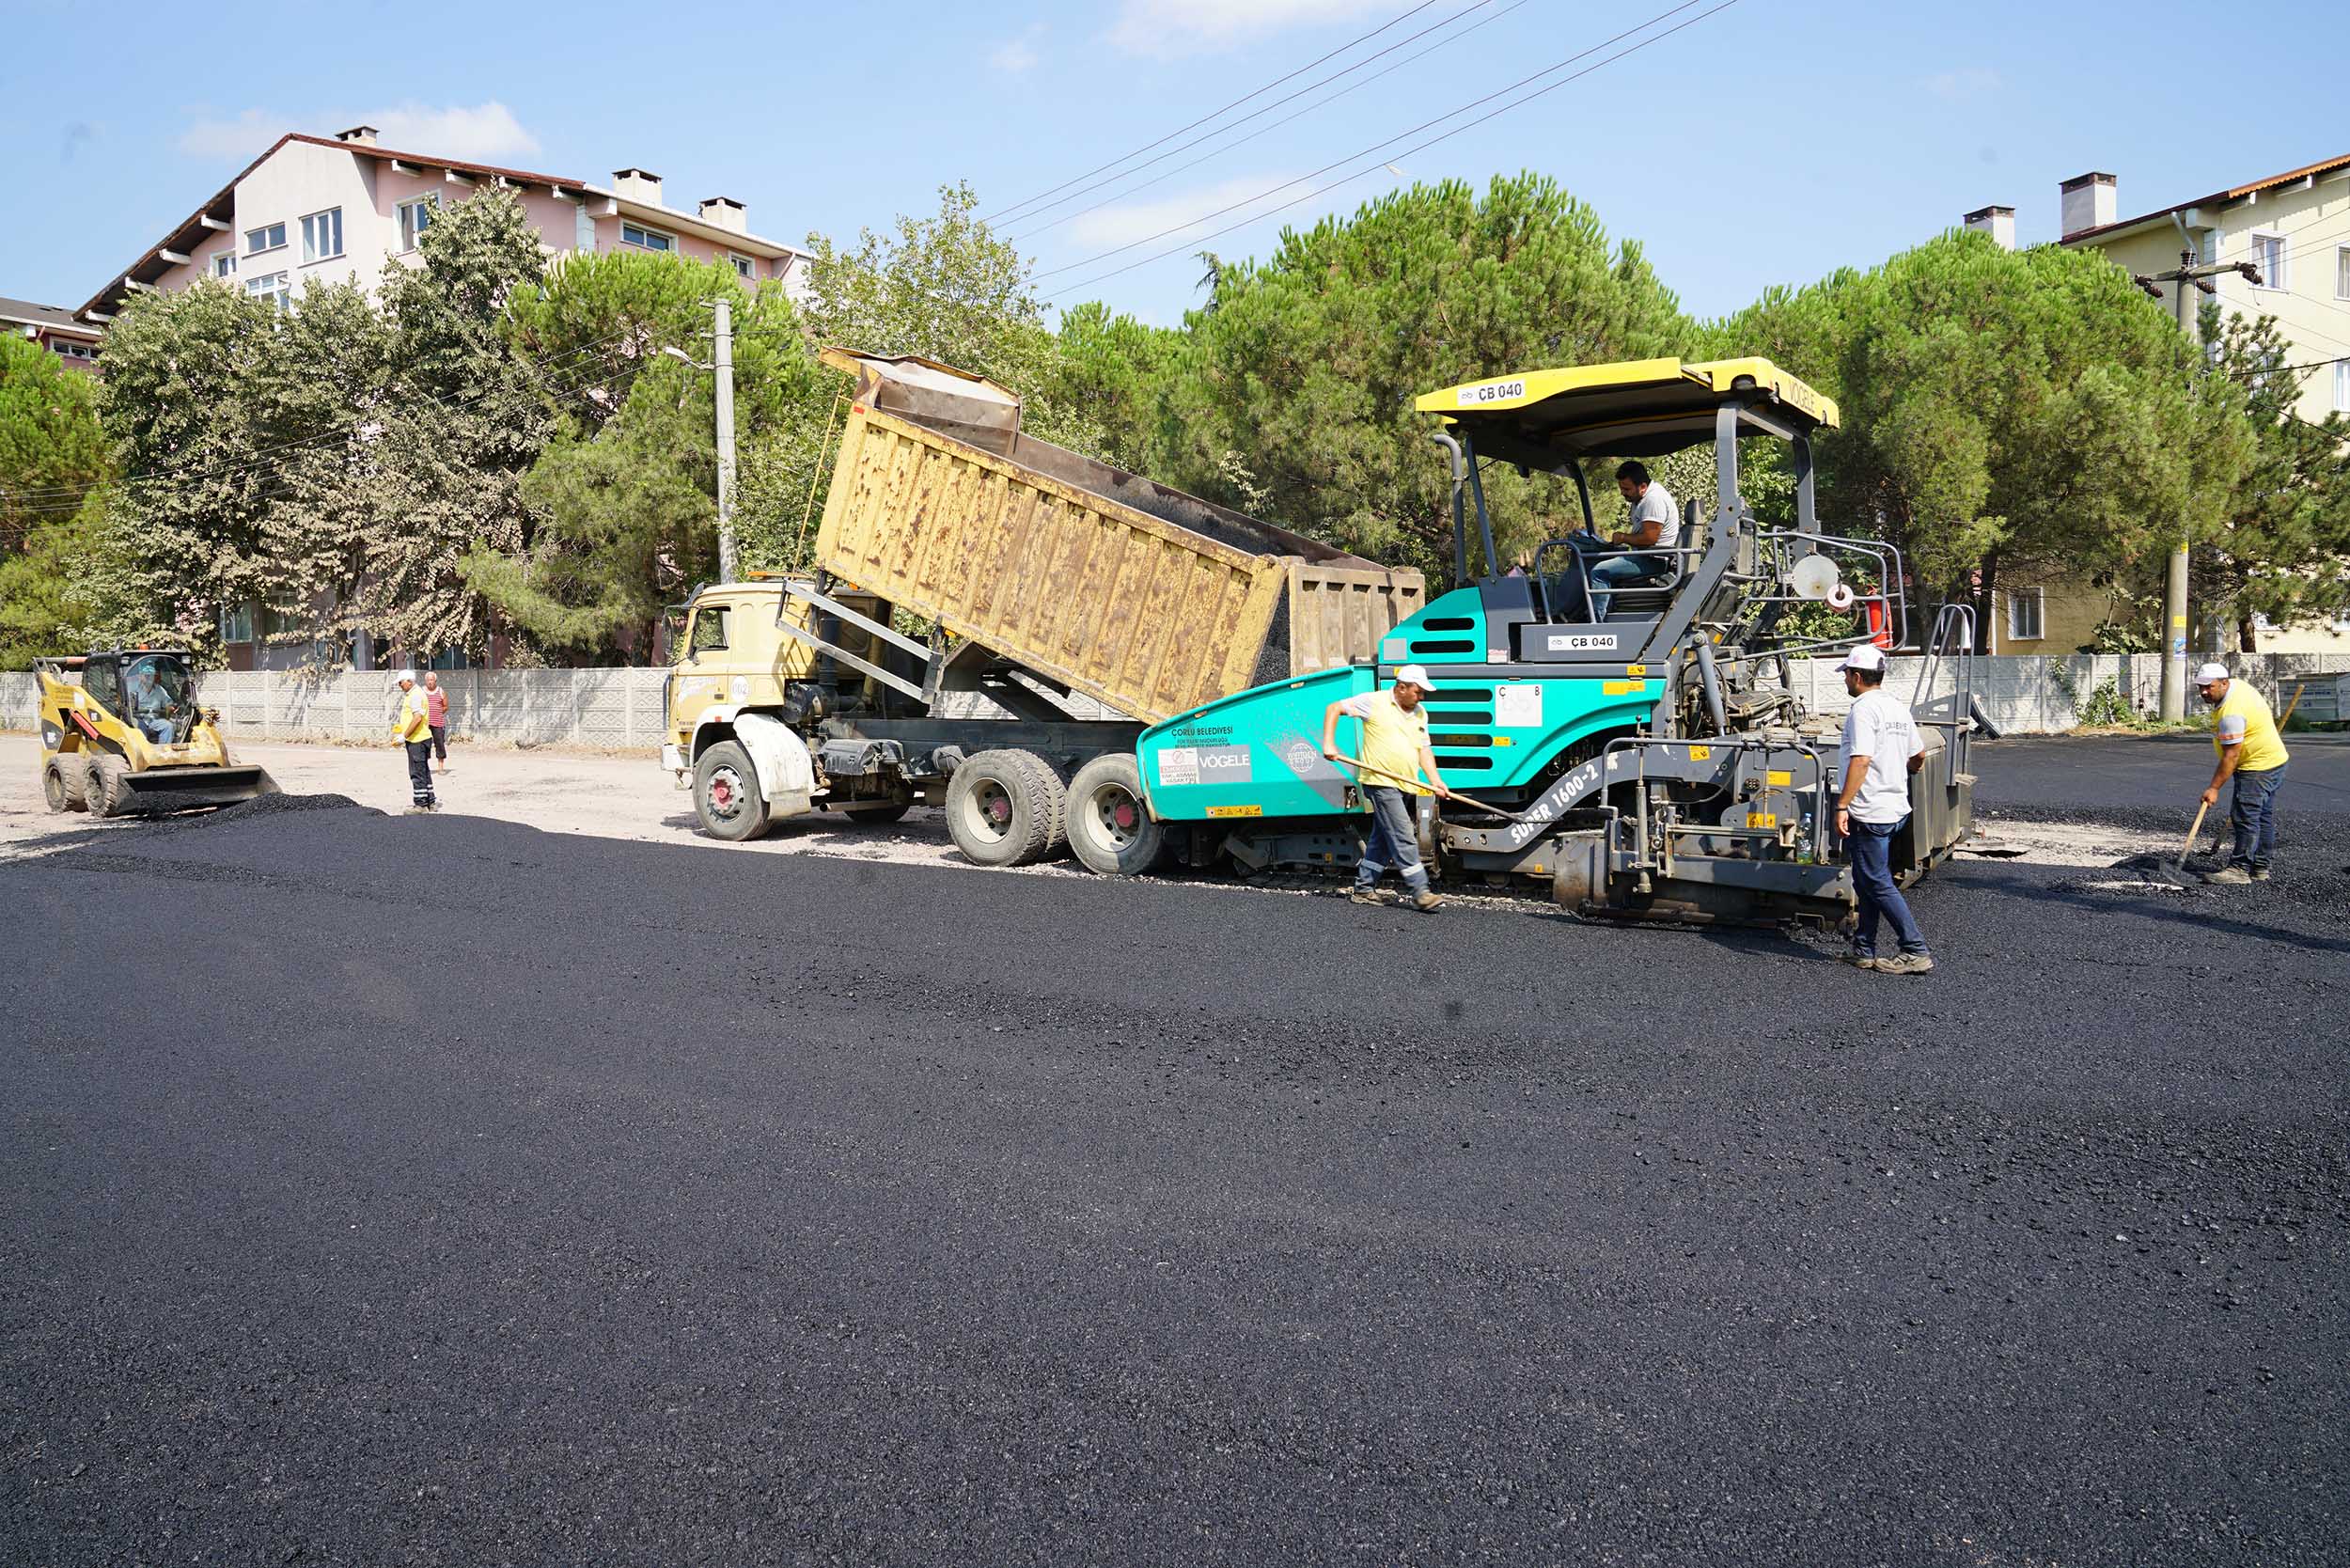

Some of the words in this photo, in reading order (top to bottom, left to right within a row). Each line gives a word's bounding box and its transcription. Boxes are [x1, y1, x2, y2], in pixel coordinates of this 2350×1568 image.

[1498, 383, 1522, 398] 040
[1572, 637, 1588, 649] ÇB
[1591, 637, 1614, 647] 040
[1198, 753, 1249, 768] VÖGELE
[1551, 763, 1599, 808] 1600-2
